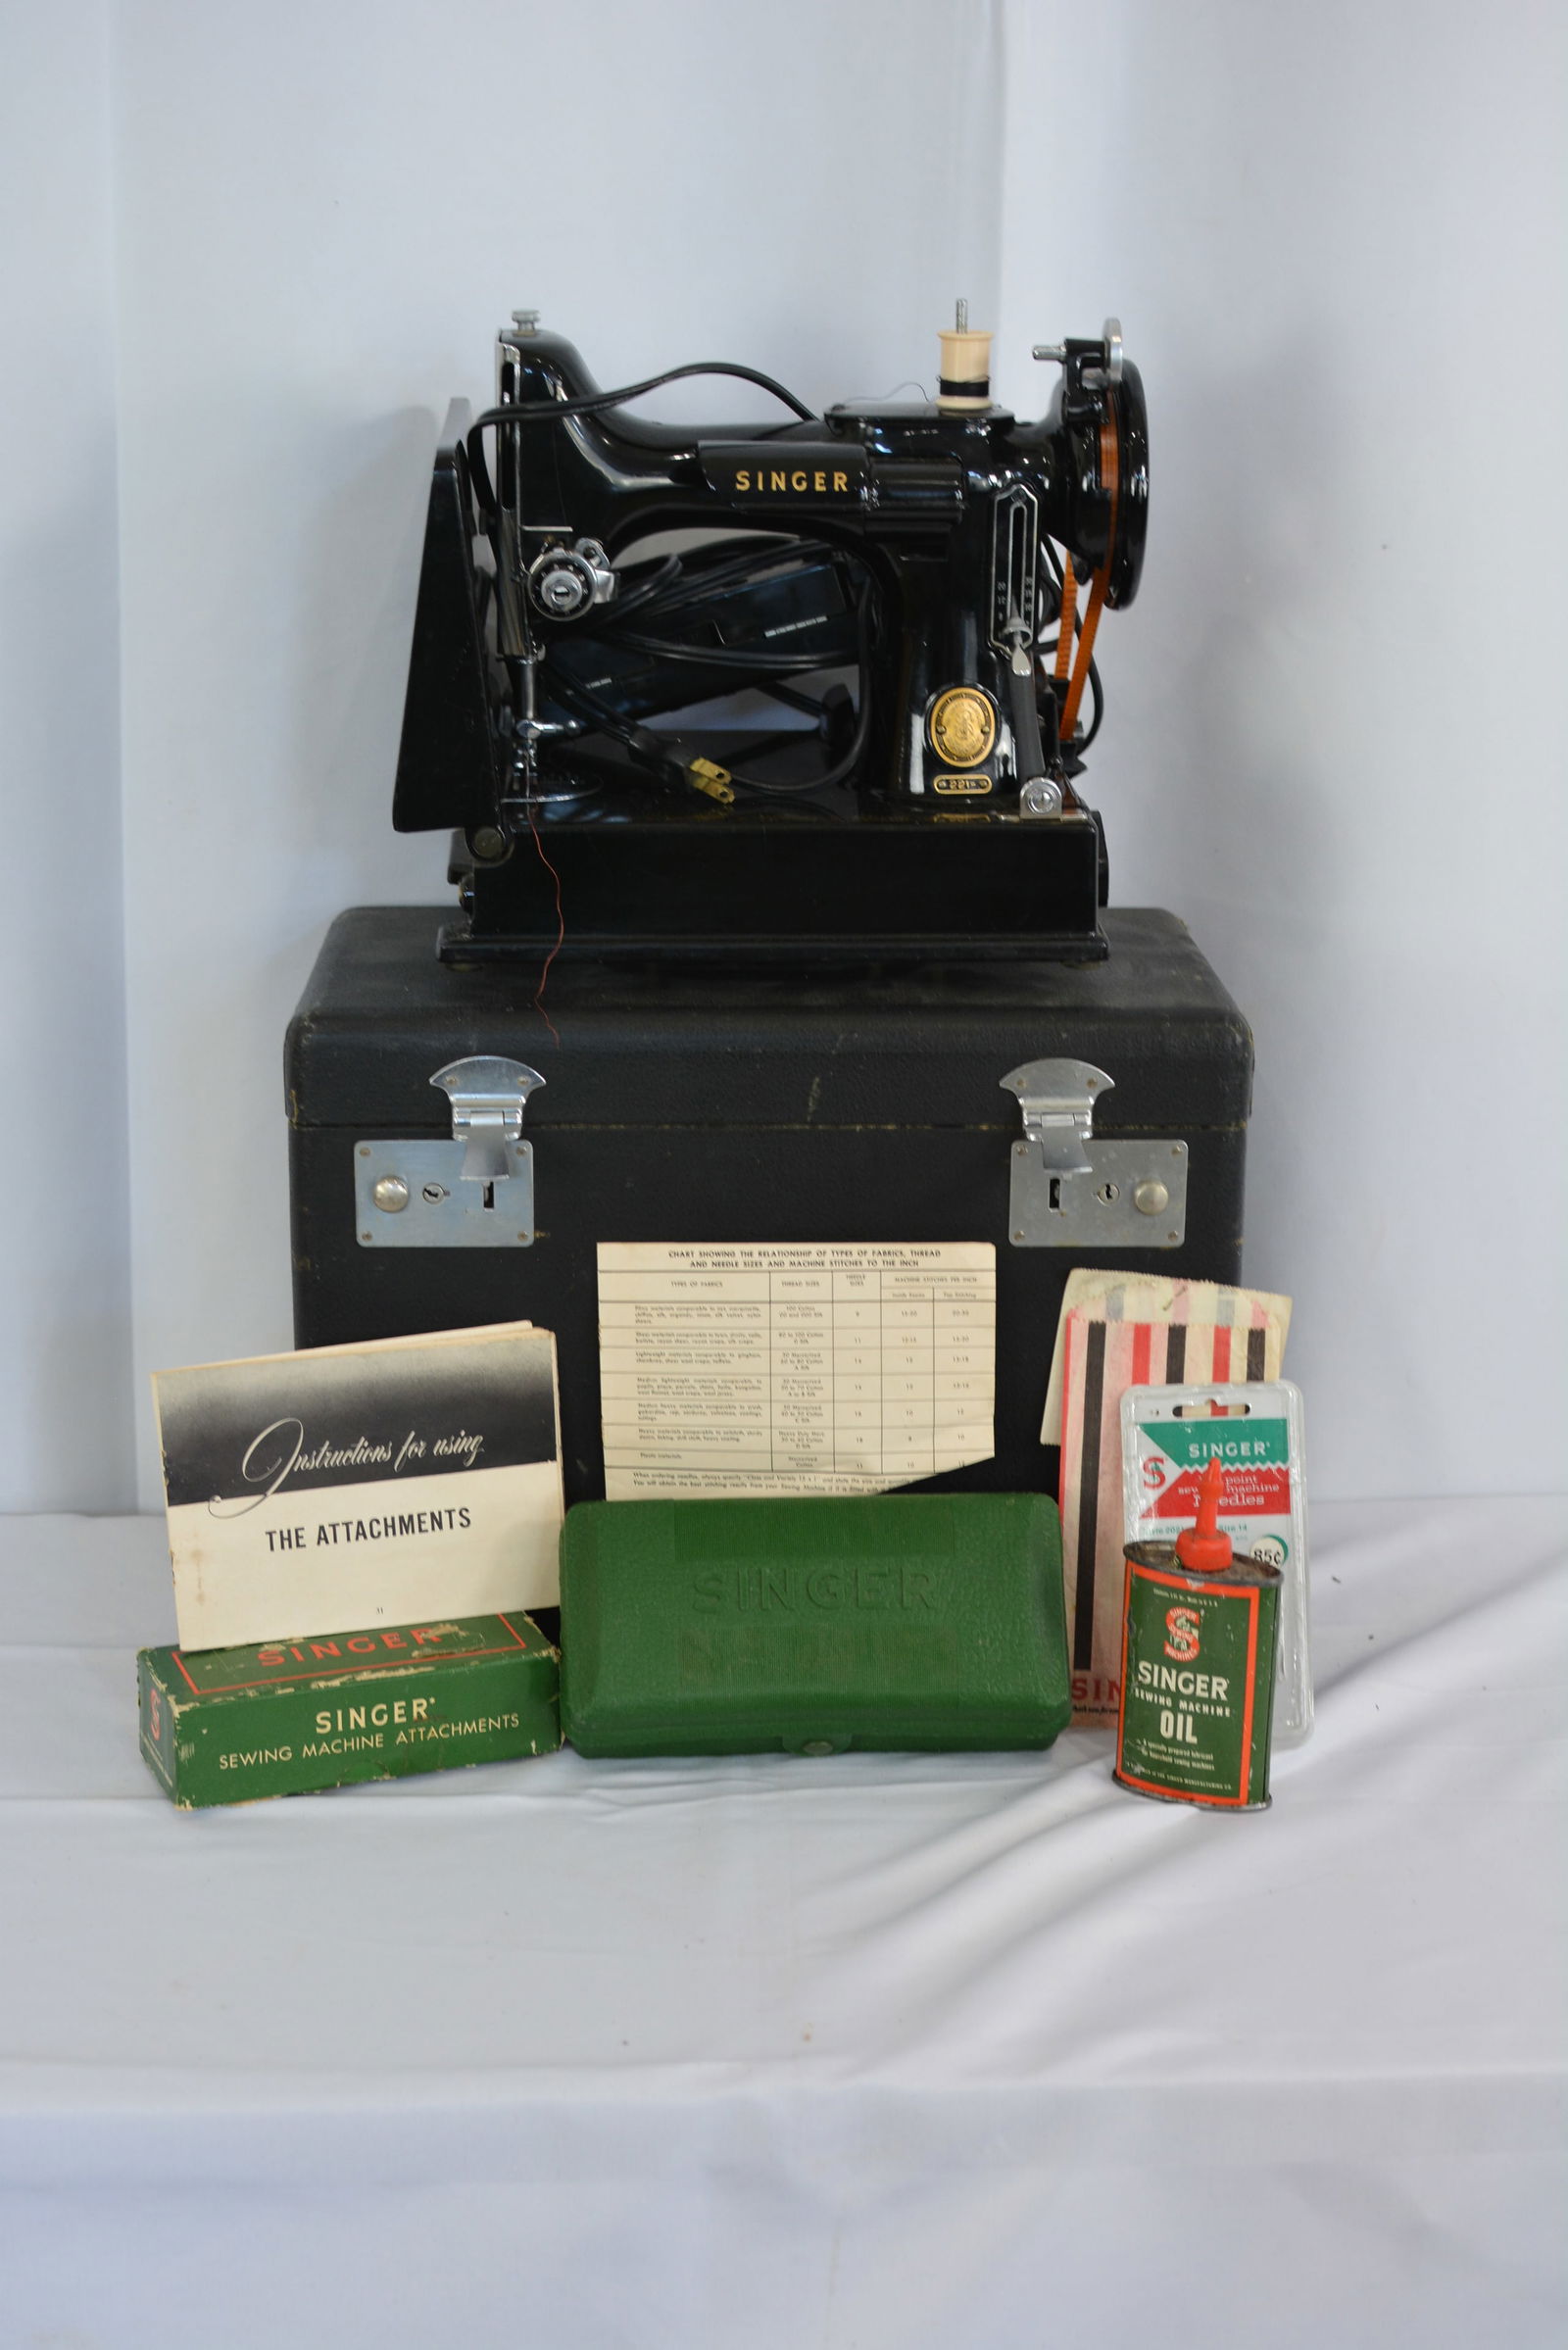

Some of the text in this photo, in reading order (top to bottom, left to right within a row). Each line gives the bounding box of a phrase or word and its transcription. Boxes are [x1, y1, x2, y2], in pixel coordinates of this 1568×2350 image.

[735, 470, 848, 491] SINGER
[872, 1249, 906, 1258] FABRICS,
[1189, 1441, 1266, 1458] SINGER
[208, 1417, 484, 1519] Instructions for using
[1143, 1456, 1166, 1490] S
[1226, 1475, 1257, 1487] point
[1194, 1494, 1264, 1507] Nedles
[1227, 1482, 1279, 1493] machine
[266, 1507, 471, 1551] THE ATTACHMENTS
[692, 1565, 938, 1615] SINGER
[258, 1628, 443, 1667] SINGER
[1138, 1660, 1228, 1701] SINGER
[315, 1698, 429, 1735] SINGER
[1135, 1688, 1231, 1717] SEWING MACHINE
[220, 1713, 519, 1770] SEWING MACHINE ATTACHMENTS
[1160, 1710, 1198, 1744] OIL
